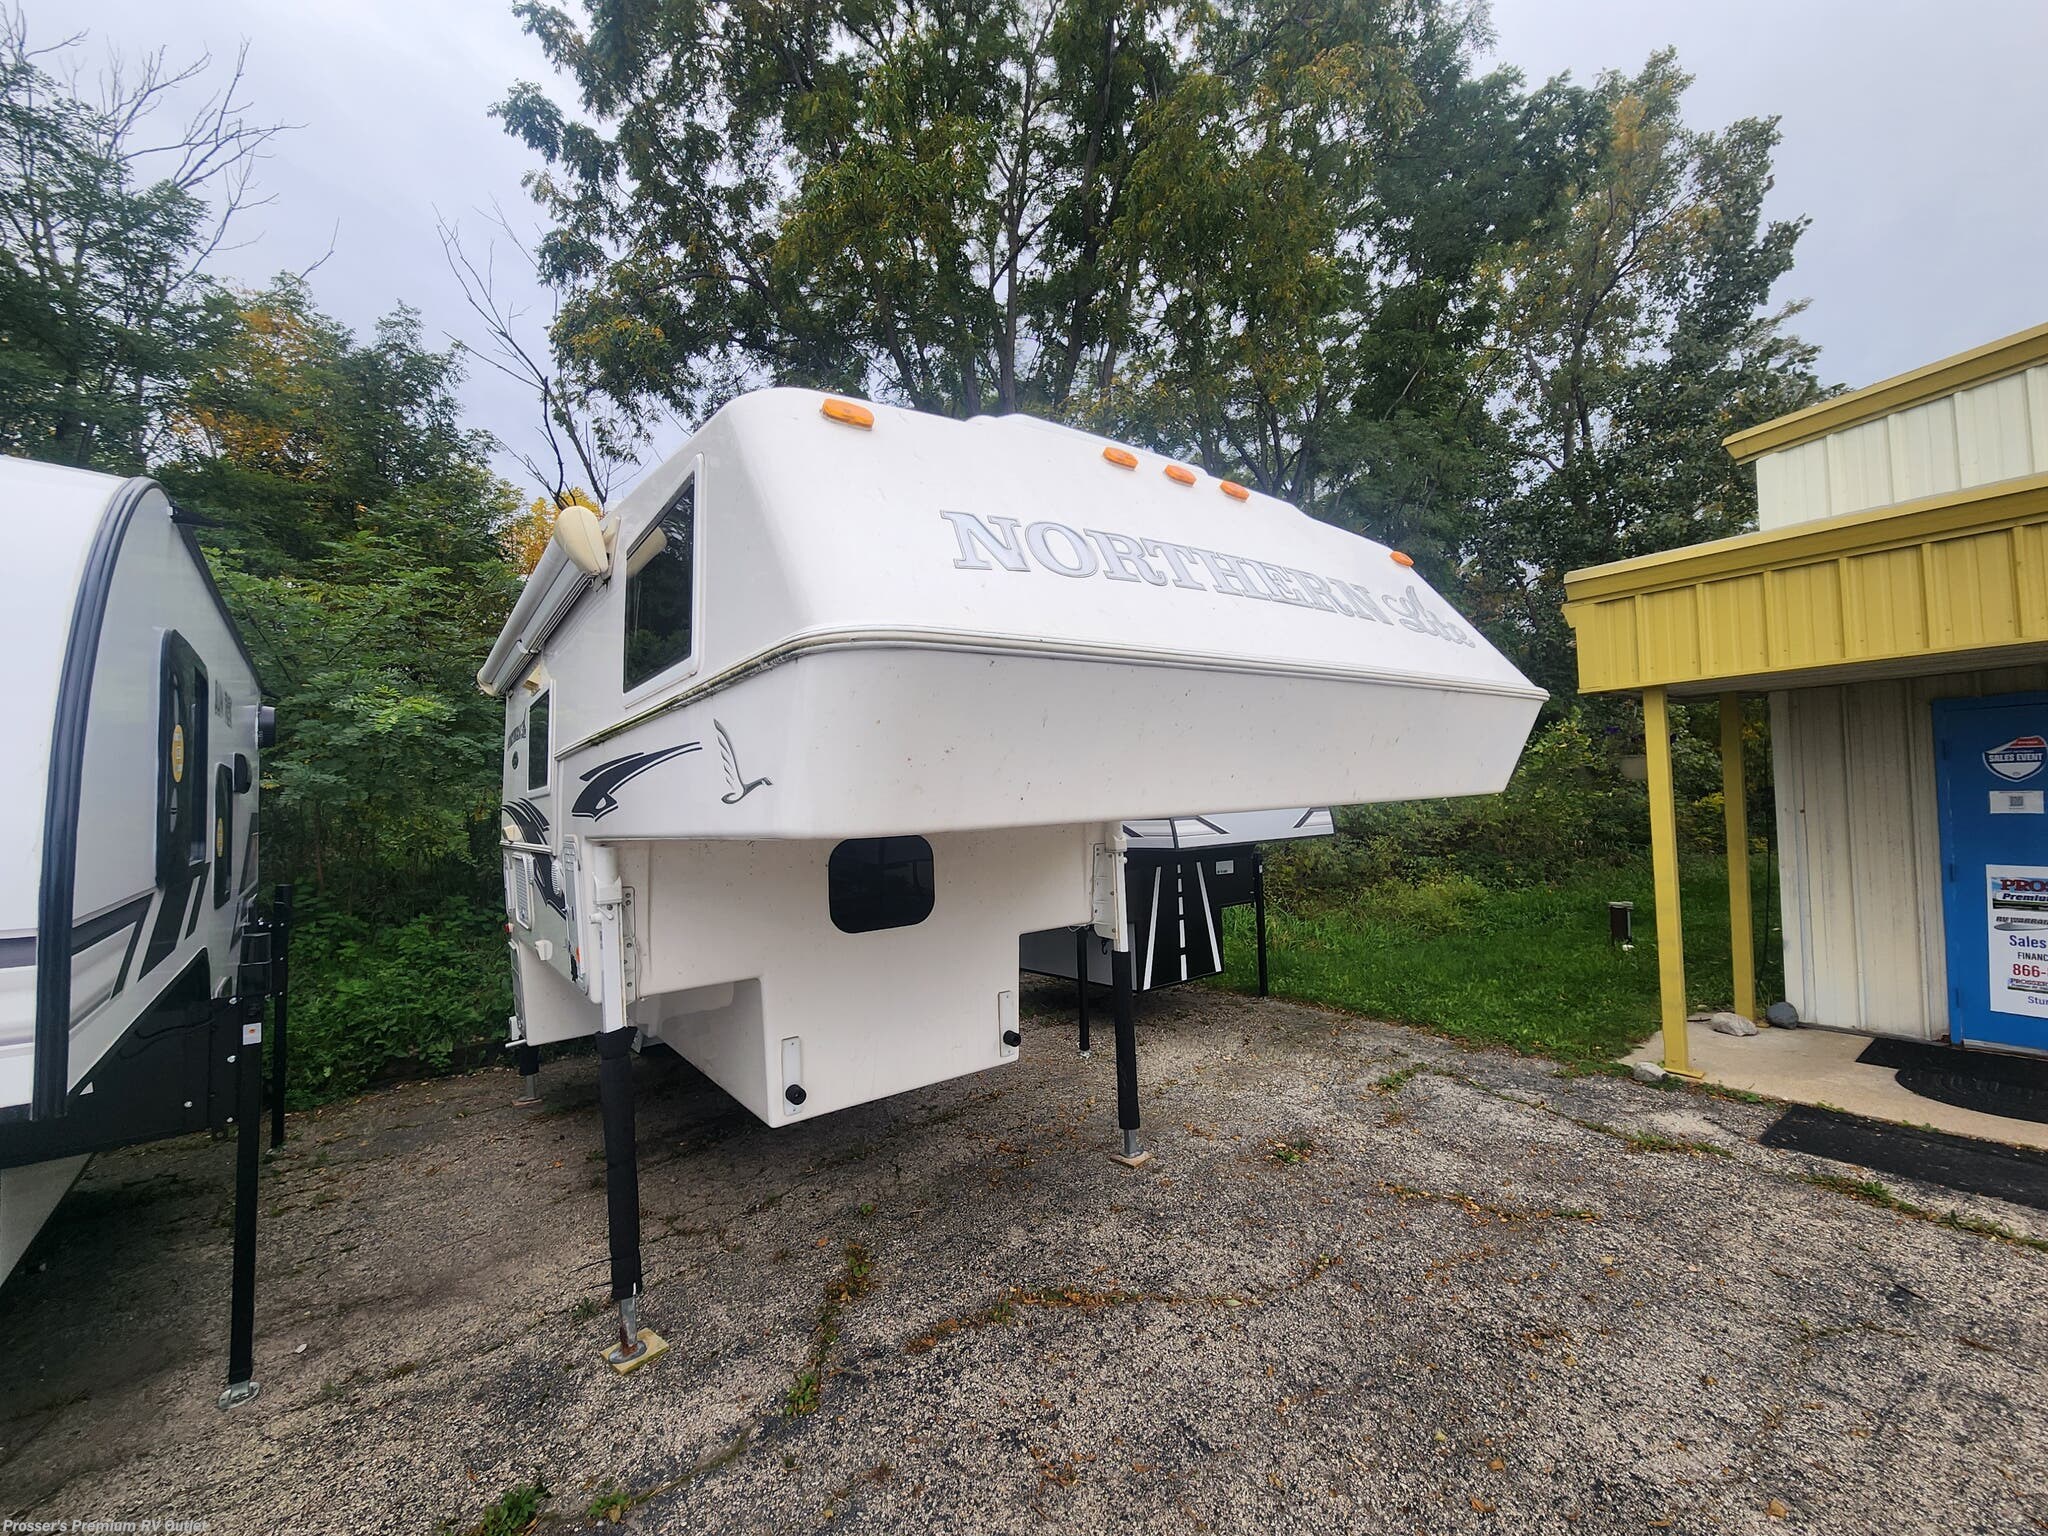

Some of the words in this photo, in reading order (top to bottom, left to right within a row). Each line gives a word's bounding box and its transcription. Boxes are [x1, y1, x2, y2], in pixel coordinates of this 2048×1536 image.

[940, 510, 1394, 626] NORTHERN
[1382, 585, 1476, 648] Lite
[1989, 754, 2015, 762] SALES
[2016, 753, 2043, 761] EVENT
[2000, 879, 2048, 892] PRO
[2009, 935, 2047, 949] Sales
[2013, 963, 2048, 977] 866-
